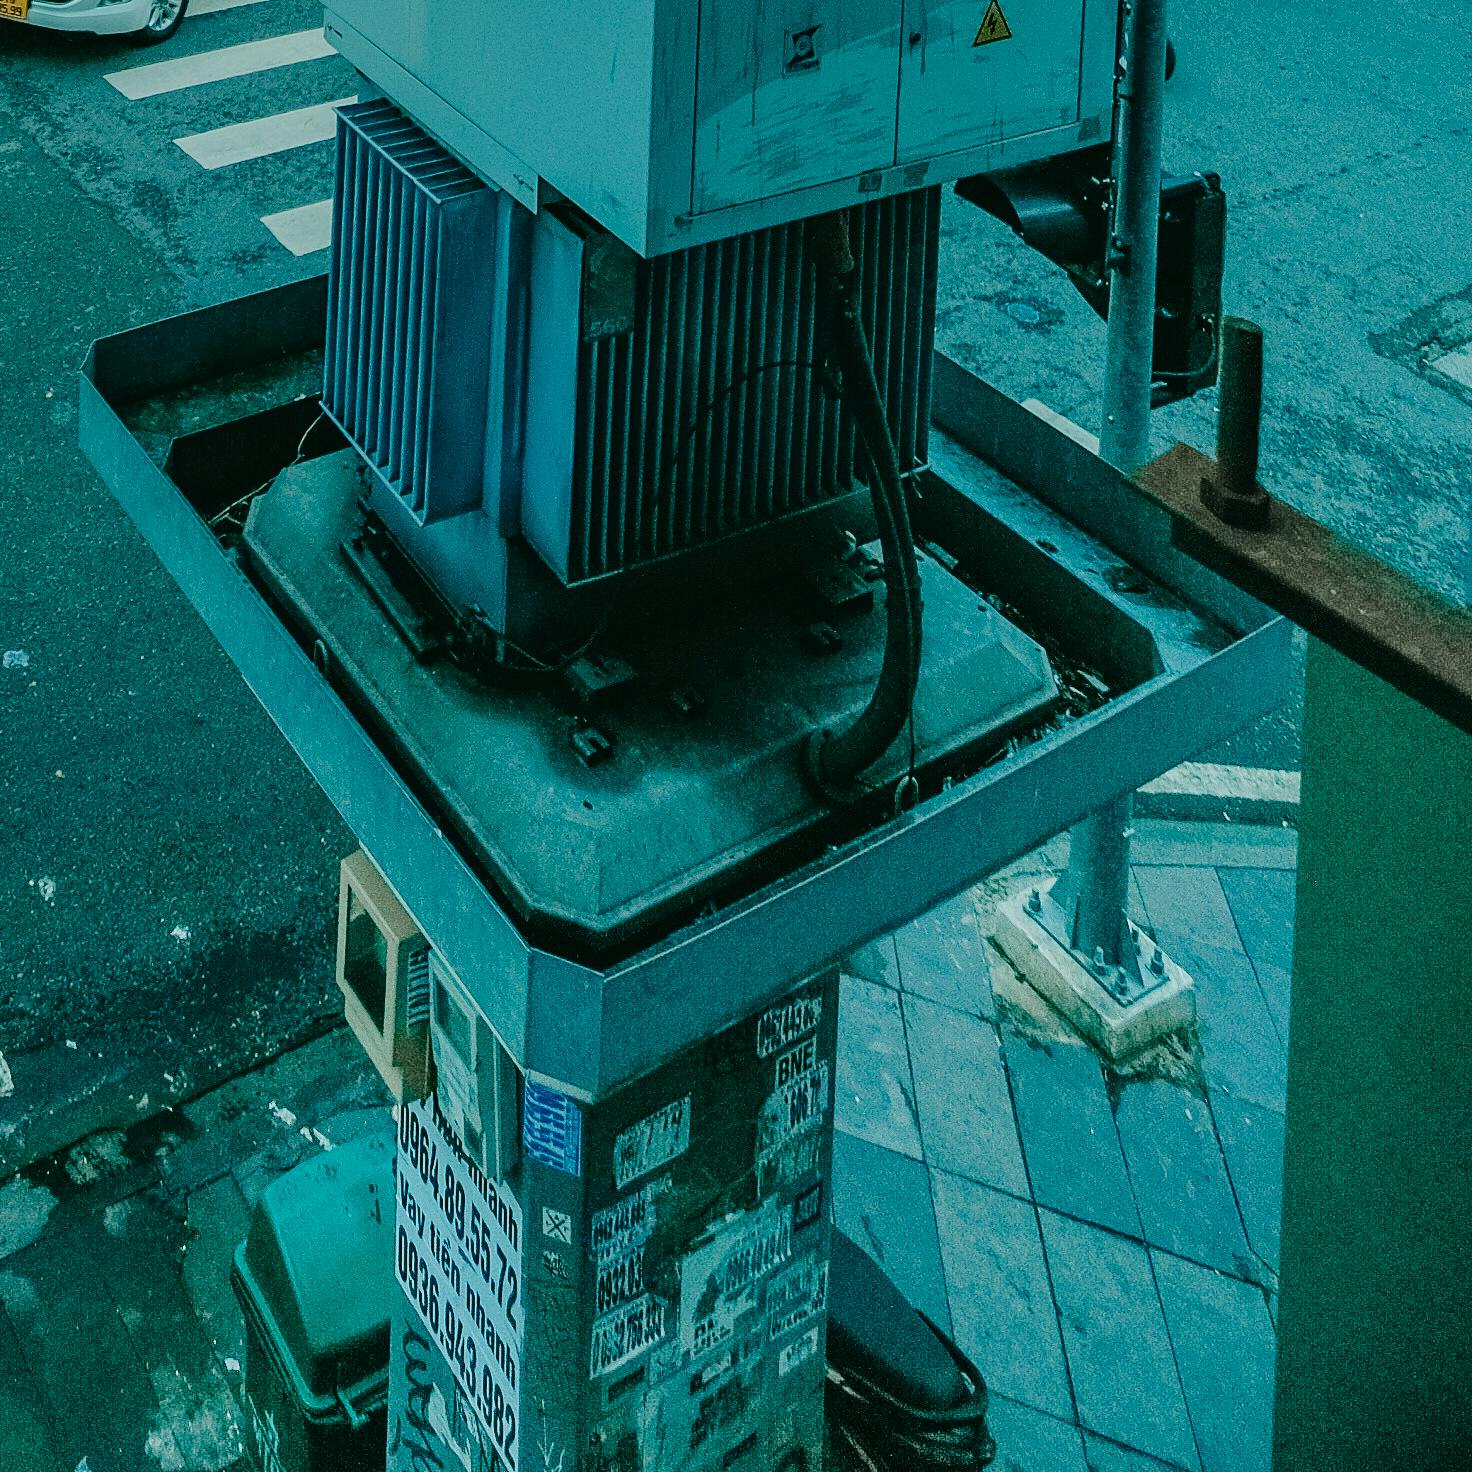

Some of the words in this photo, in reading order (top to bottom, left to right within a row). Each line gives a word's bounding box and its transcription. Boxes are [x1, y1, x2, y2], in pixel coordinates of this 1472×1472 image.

[399, 1106, 517, 1333] 0964.89.55.72
[399, 1170, 426, 1240] Vay
[466, 1280, 516, 1391] nhanh
[398, 1224, 516, 1472] 0936.943.982
